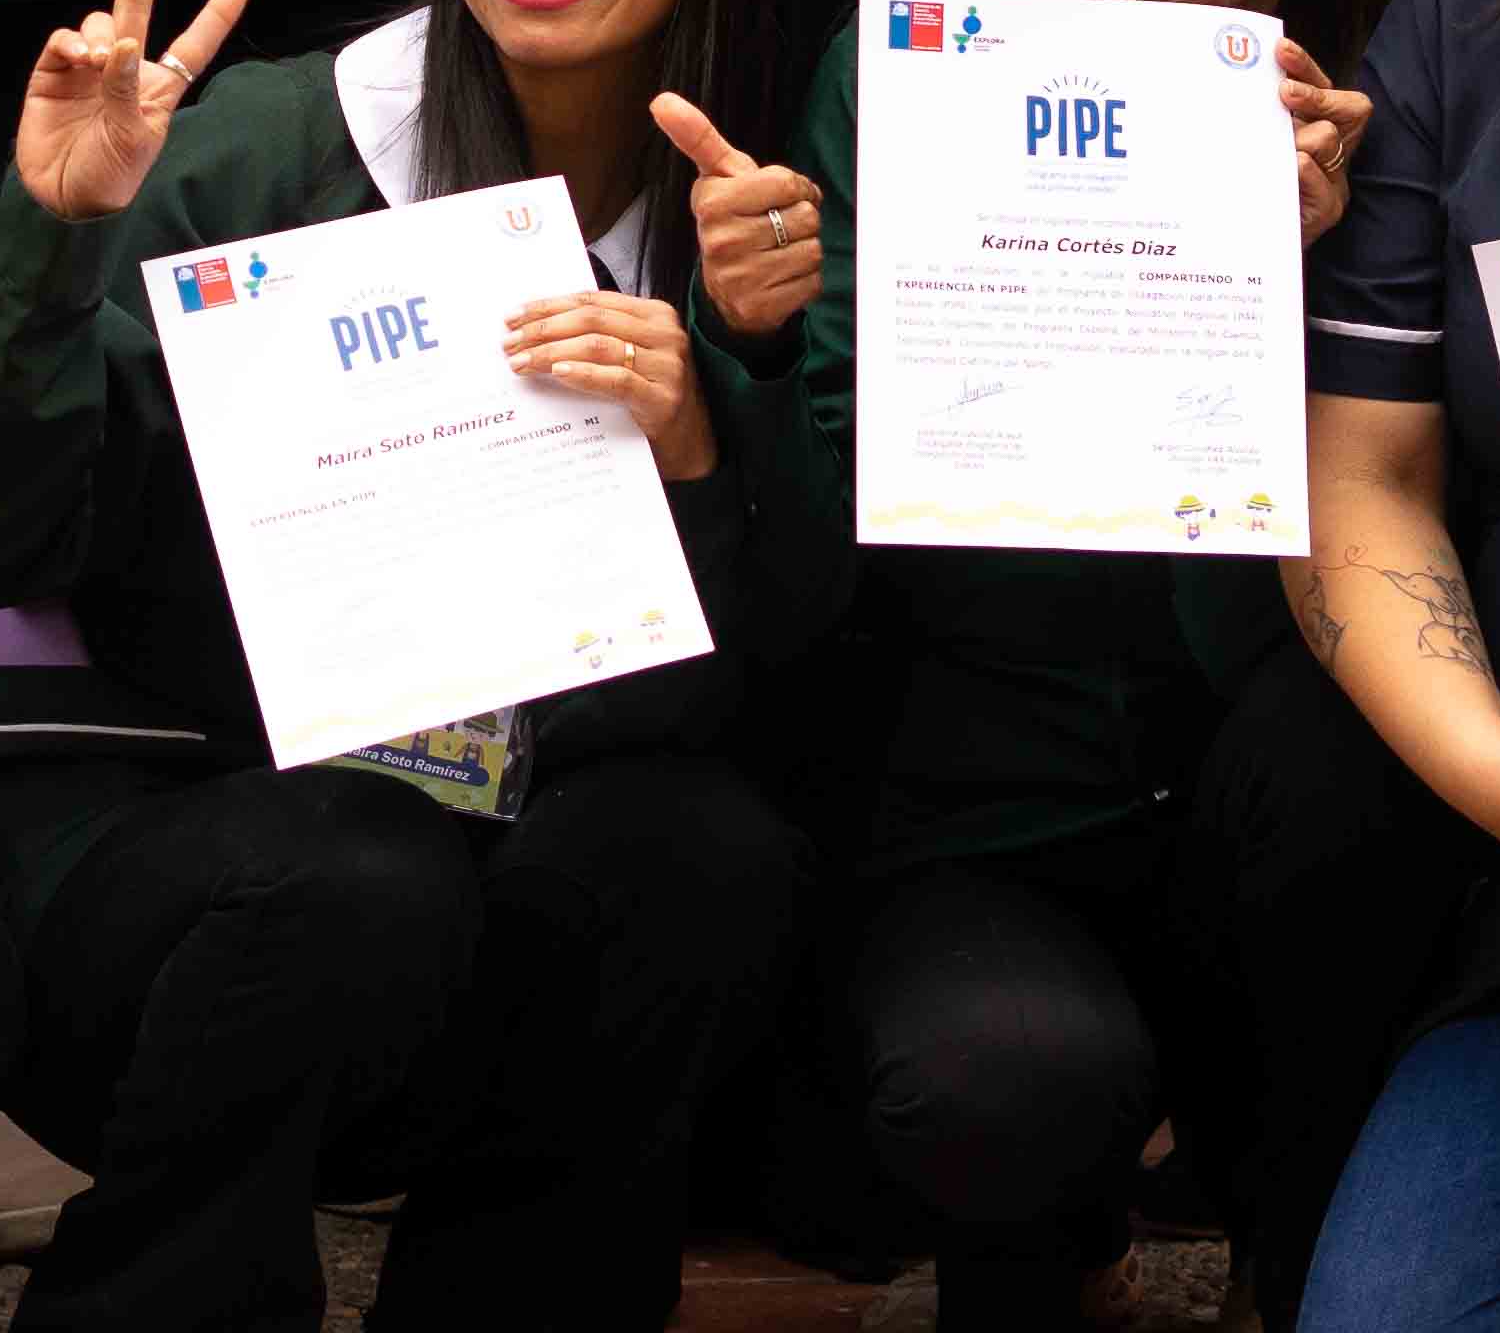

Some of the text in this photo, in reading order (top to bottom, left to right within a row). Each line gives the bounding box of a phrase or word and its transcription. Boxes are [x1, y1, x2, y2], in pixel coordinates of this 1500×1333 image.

[1026, 95, 1127, 158] PIPE
[981, 234, 1049, 251] Karina
[1057, 237, 1124, 254] Cortés
[896, 279, 1027, 294] EXPERIENCIA EN PIPE
[1138, 271, 1261, 285] COMPARTIENDO MI
[329, 296, 439, 371] PIPE
[344, 746, 379, 762] aira
[381, 751, 412, 768] Soto
